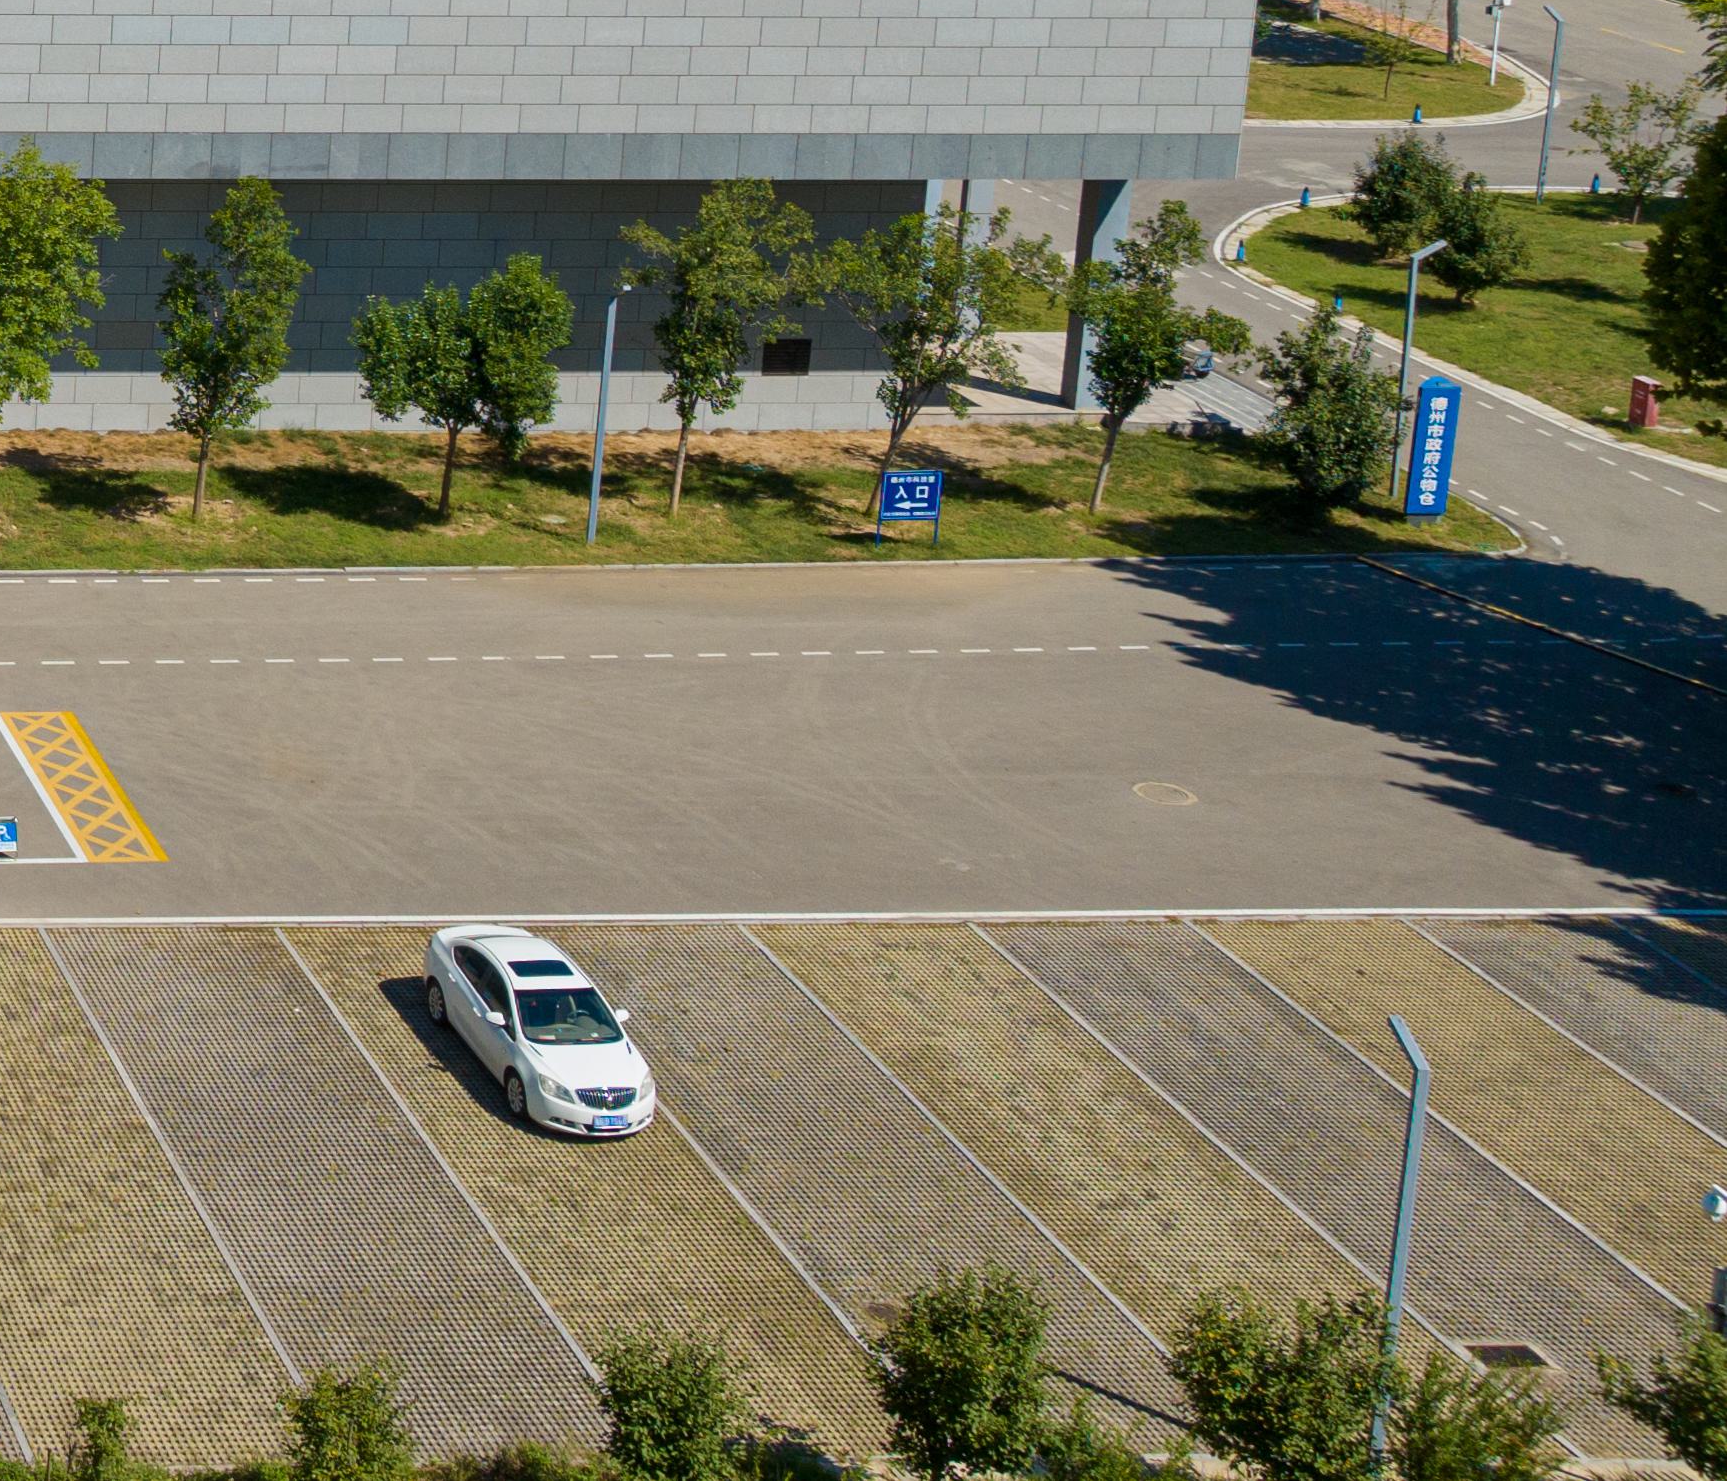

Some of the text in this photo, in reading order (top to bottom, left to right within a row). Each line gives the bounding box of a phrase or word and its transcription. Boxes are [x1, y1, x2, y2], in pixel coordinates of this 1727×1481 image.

[1419, 396, 1448, 506] 德州市政府公物仓
[895, 486, 929, 499] 入口
